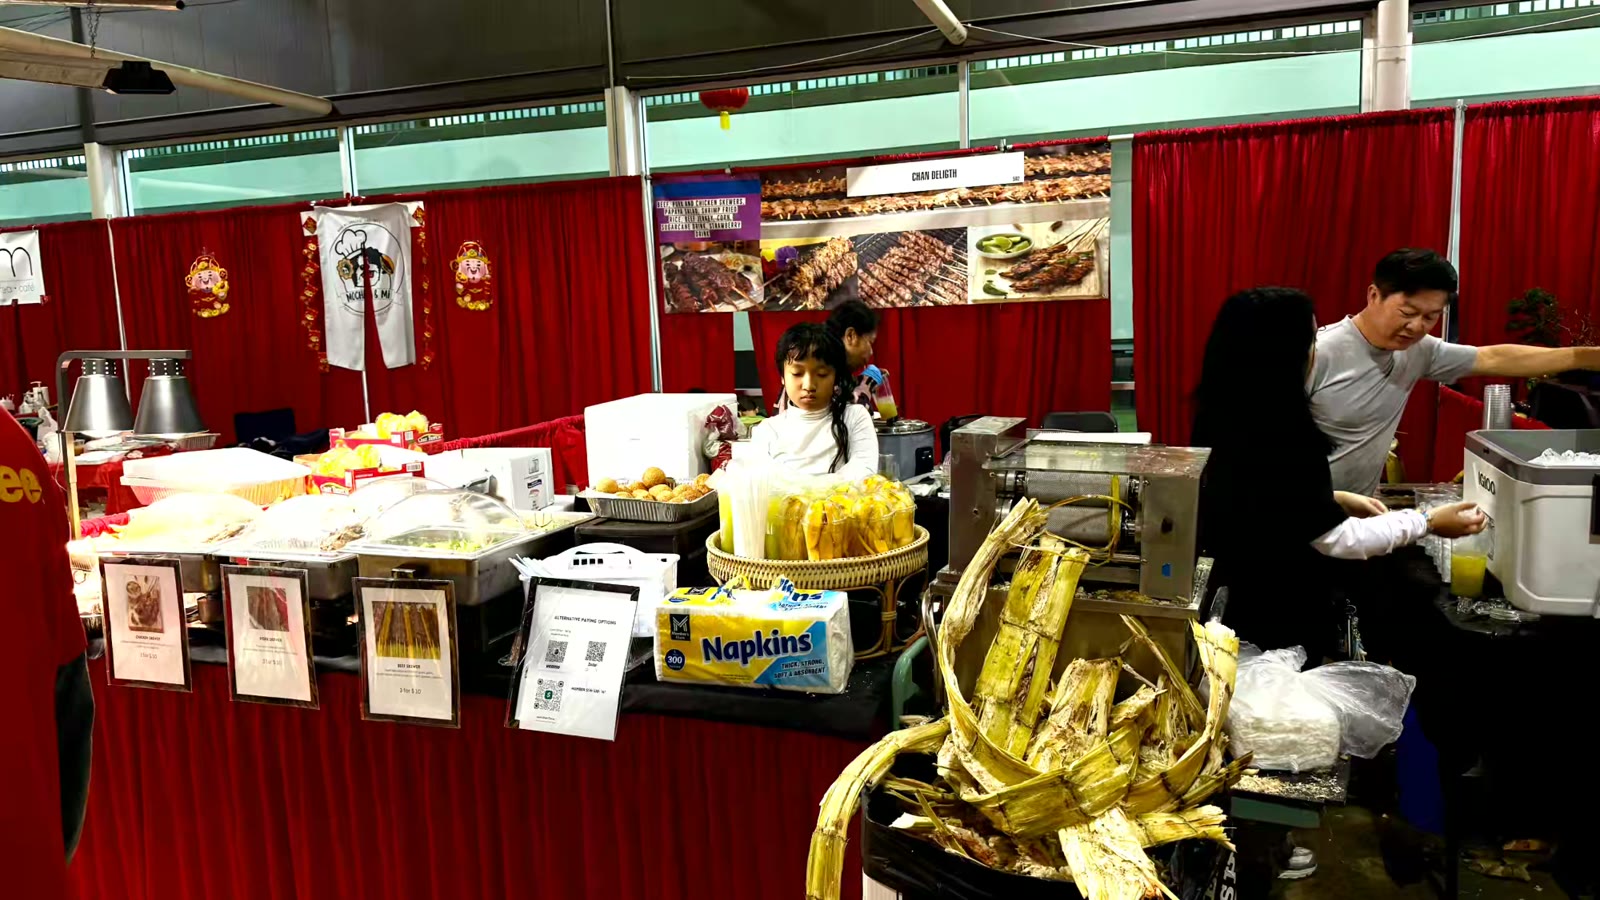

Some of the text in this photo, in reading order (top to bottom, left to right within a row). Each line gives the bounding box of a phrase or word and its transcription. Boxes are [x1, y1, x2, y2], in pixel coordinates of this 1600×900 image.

[912, 168, 958, 182] CHAN DELIGTH
[702, 629, 812, 666] Napkins
[667, 656, 682, 664] 300
[800, 659, 824, 667] STRONG,
[794, 667, 826, 676] ABSORBENT
